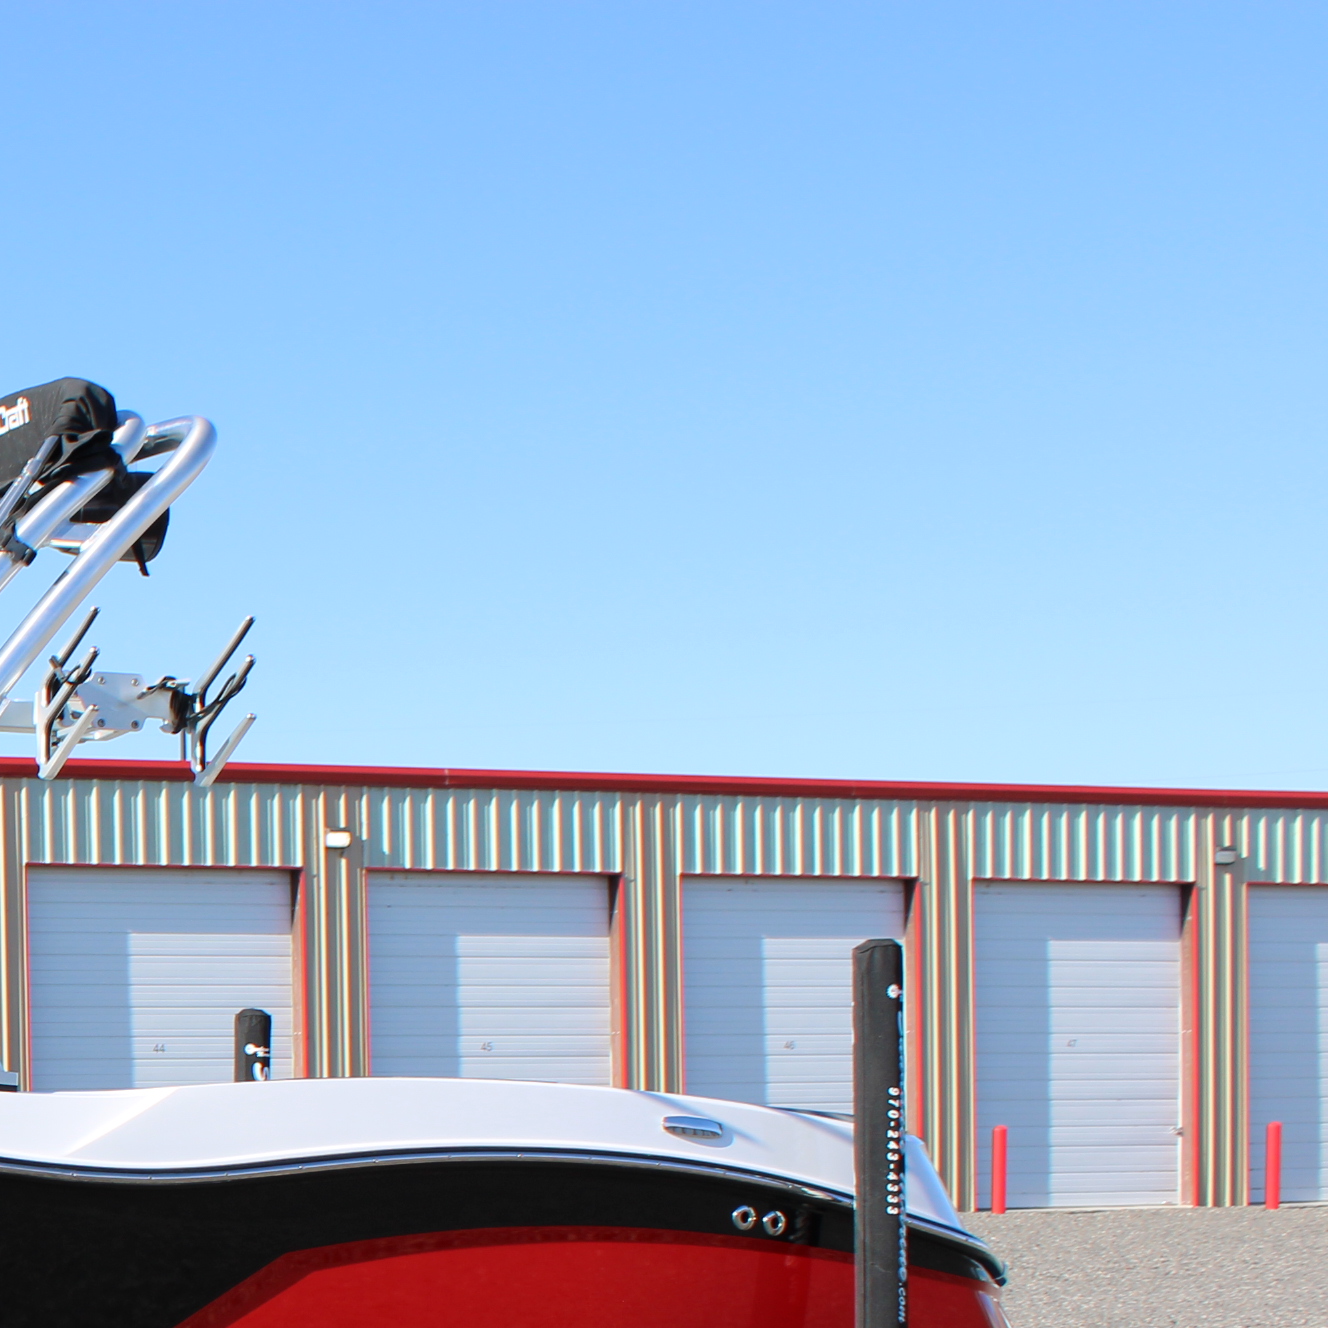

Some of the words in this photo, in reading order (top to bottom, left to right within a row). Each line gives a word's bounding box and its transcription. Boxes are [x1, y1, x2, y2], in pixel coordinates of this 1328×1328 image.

[152, 1043, 166, 1053] 44
[480, 1041, 493, 1051] 45
[887, 1086, 900, 1215] 970-243-4333
